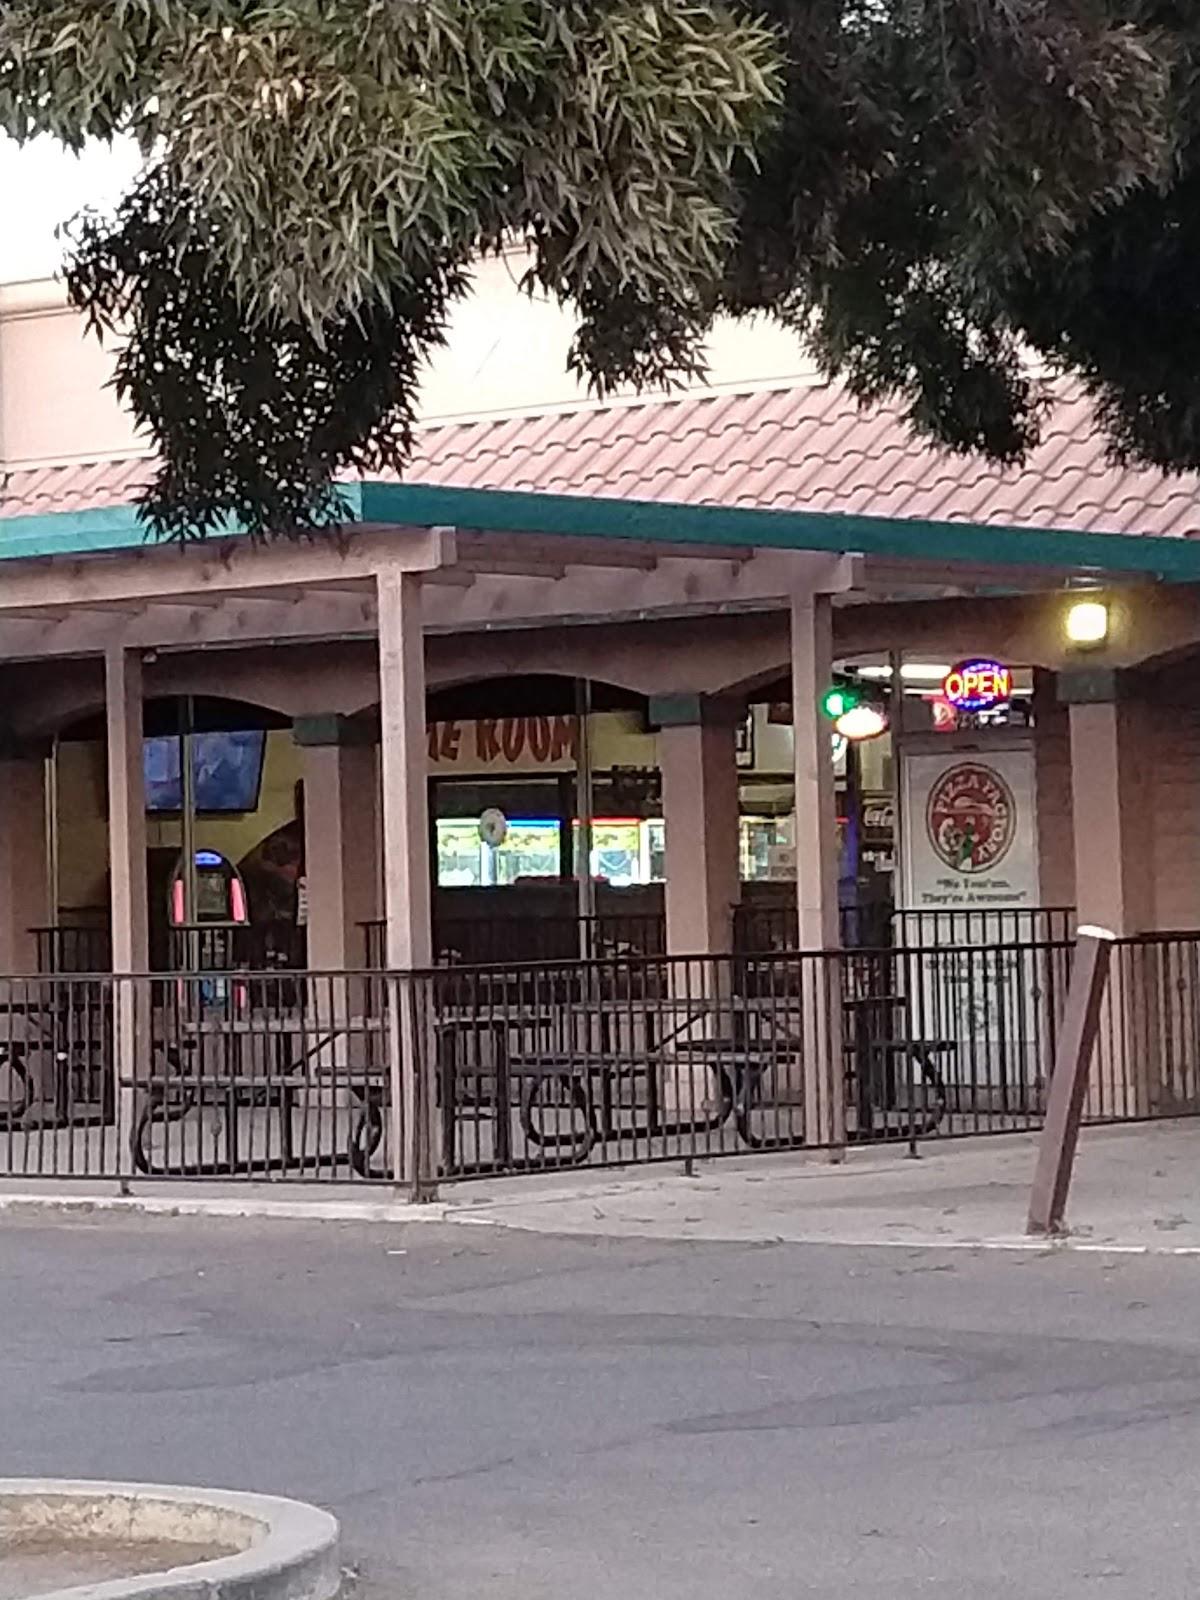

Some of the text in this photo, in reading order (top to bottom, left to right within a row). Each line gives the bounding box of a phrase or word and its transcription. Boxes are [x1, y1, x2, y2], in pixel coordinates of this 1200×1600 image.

[944, 671, 1008, 702] OPEN
[935, 774, 1009, 862] PIZZA FACTORY
